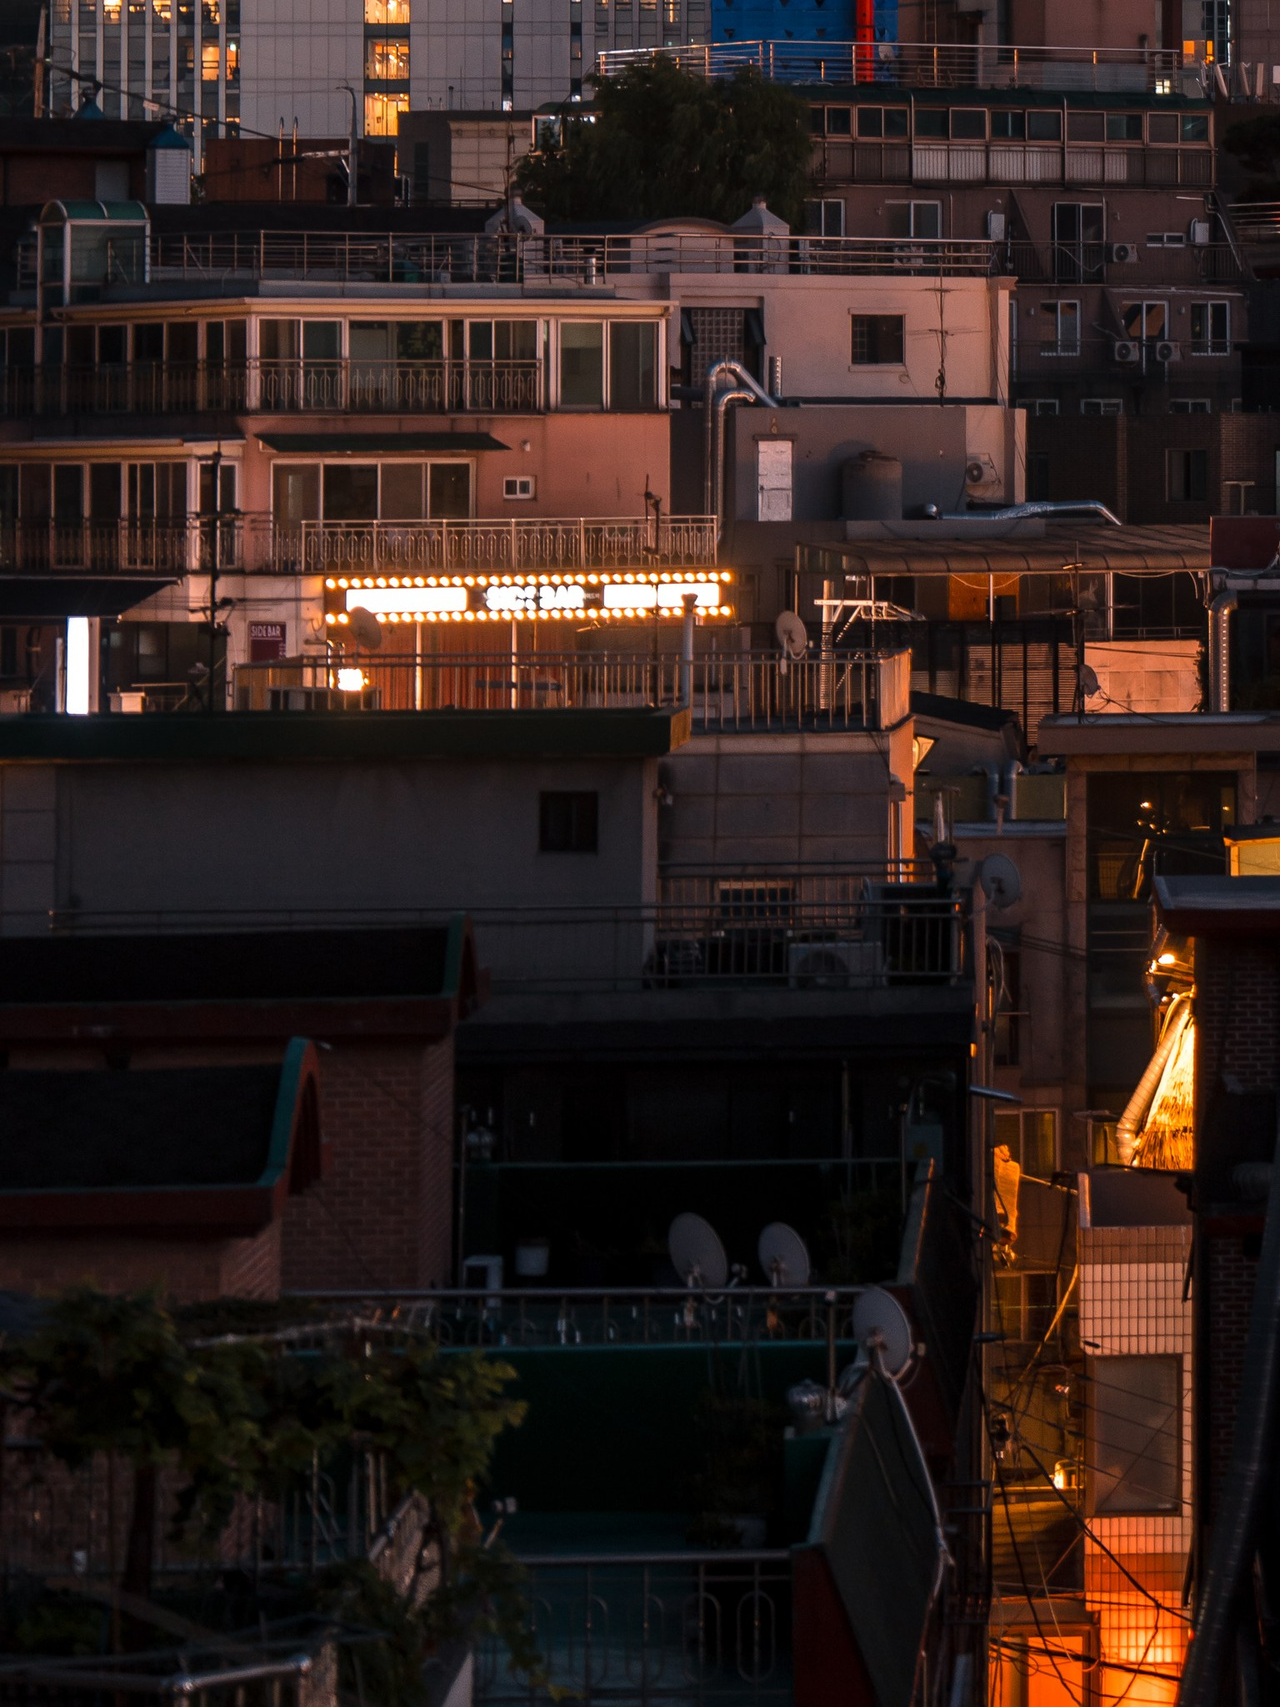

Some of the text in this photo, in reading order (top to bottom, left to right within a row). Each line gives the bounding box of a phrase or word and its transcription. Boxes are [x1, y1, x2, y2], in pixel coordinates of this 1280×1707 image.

[540, 585, 586, 610] BAR
[251, 625, 281, 637] SIDE BAR
